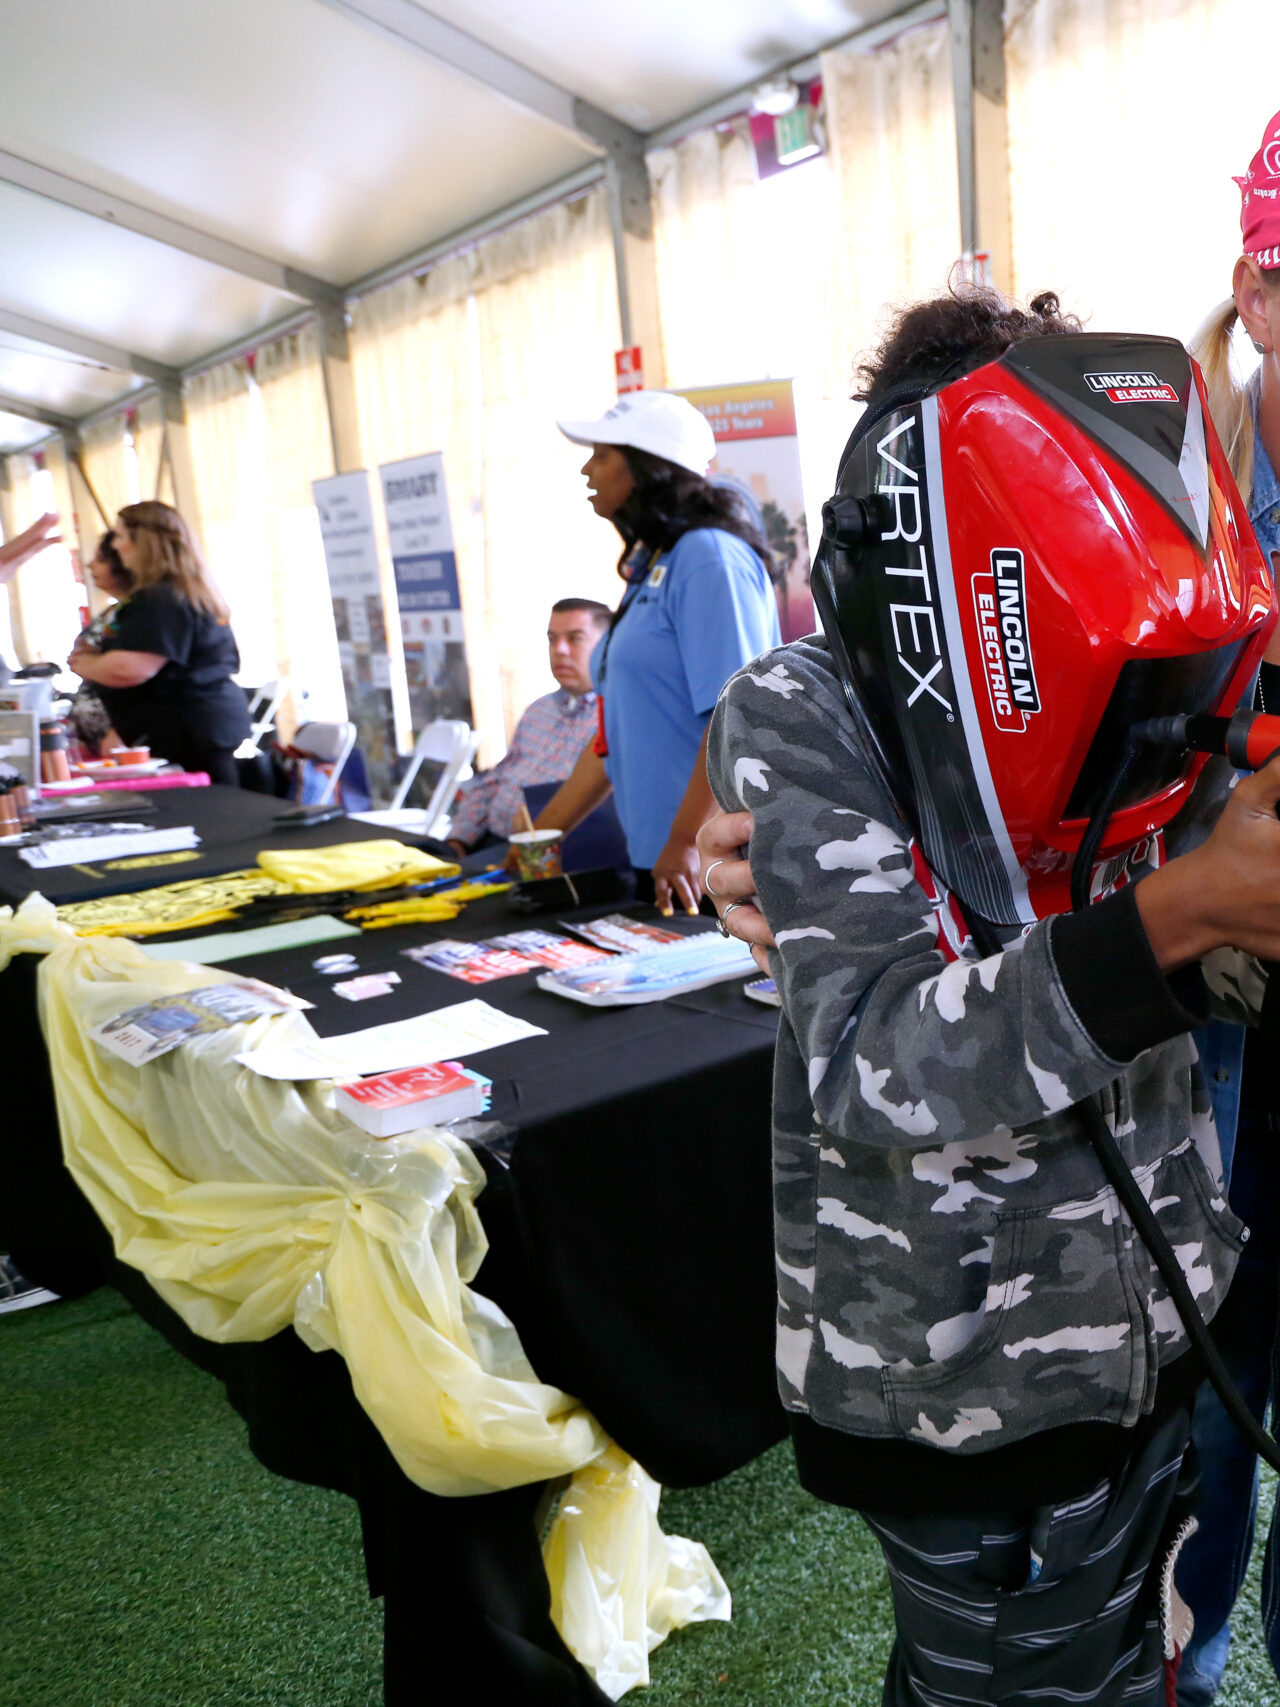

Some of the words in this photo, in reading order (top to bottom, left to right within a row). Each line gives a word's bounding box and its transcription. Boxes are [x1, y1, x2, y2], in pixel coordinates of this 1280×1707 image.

[1089, 375, 1158, 389] LINCOLN
[1115, 389, 1172, 400] ELECTRIC
[724, 398, 774, 415] Angeles
[996, 559, 1034, 703] LINCOLN
[978, 593, 1012, 716] ELECTRIC
